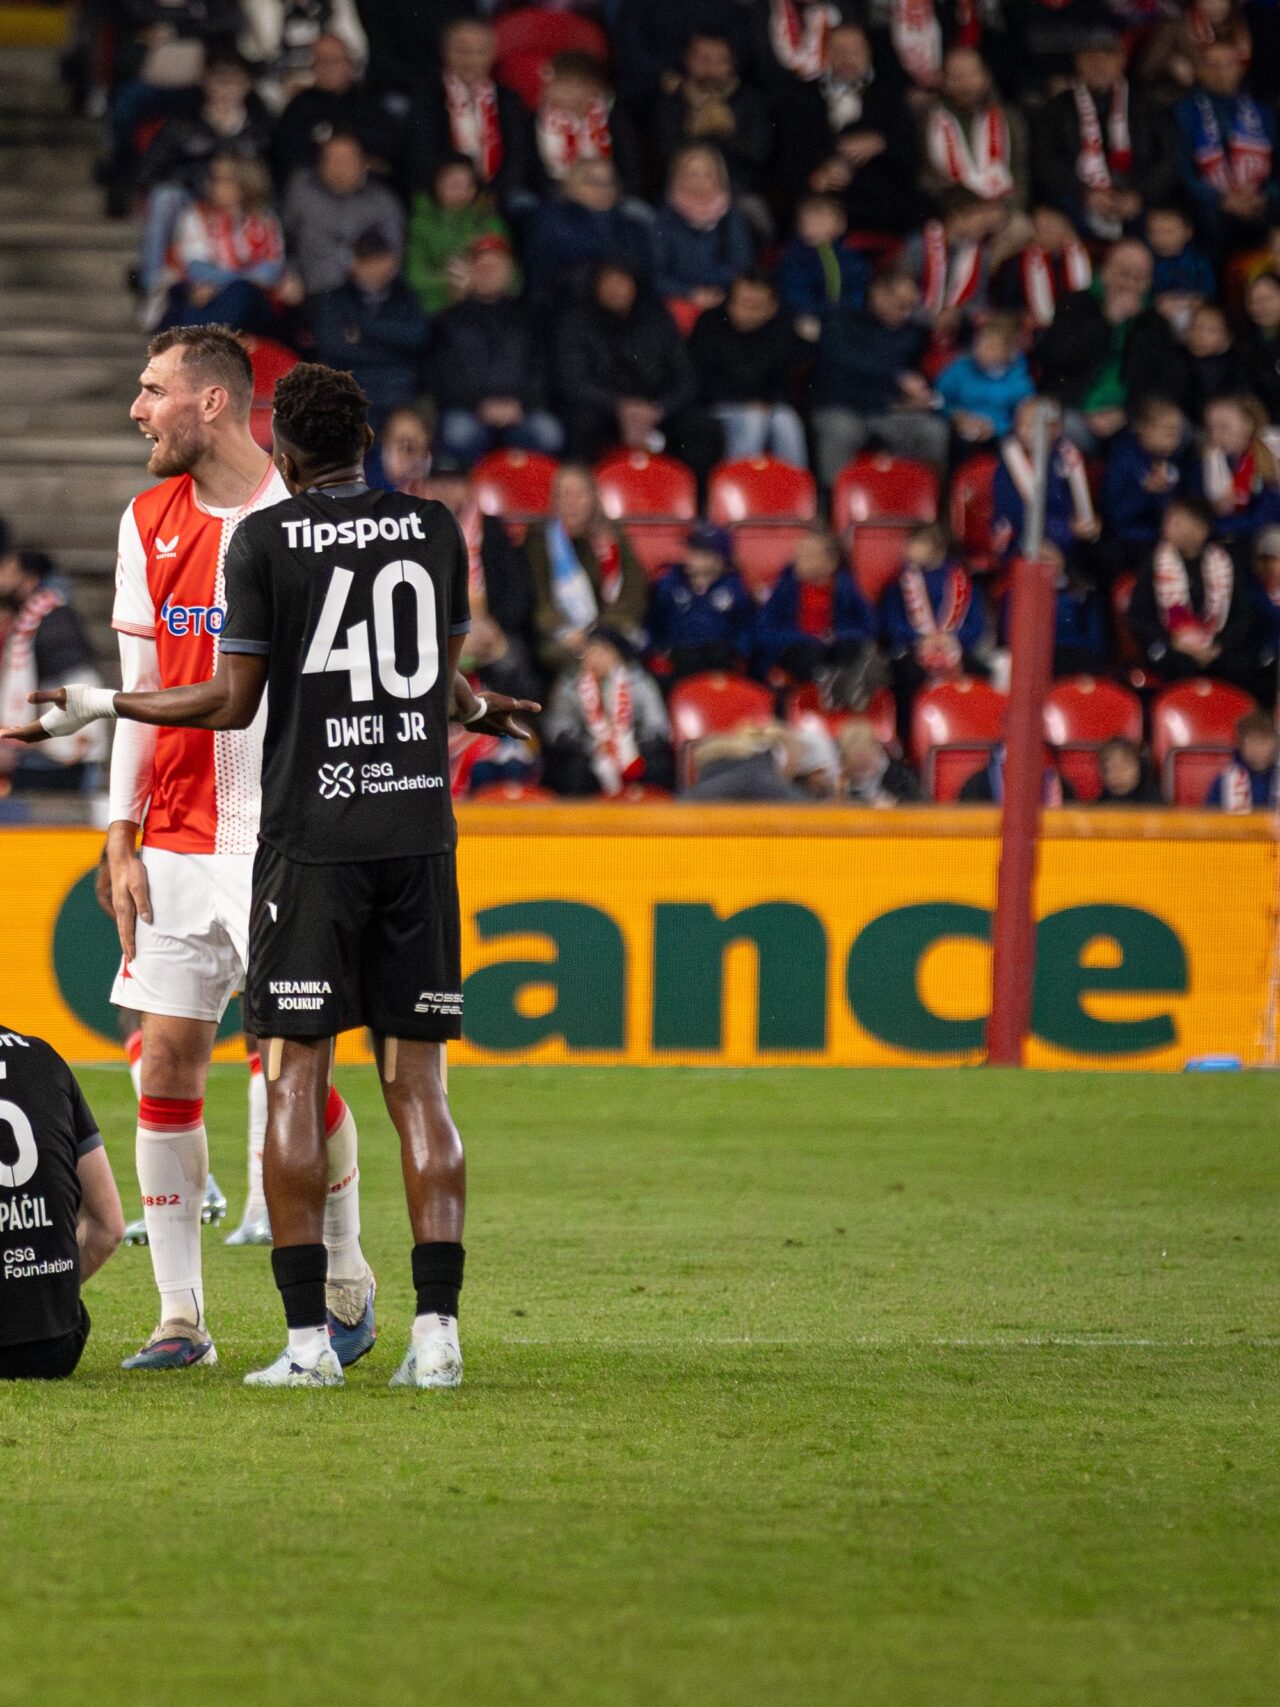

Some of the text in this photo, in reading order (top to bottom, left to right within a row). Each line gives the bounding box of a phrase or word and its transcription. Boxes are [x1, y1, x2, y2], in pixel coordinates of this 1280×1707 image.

[281, 512, 426, 553] Tipsport
[302, 559, 439, 702] 40
[325, 712, 427, 748] DWEH JR
[361, 762, 394, 779] CSG
[361, 775, 444, 795] Foundation
[52, 898, 1192, 1058] Cance
[269, 981, 332, 995] KERAMIKA
[278, 997, 324, 1011] SOUKUP
[3, 1247, 36, 1263] CSG
[4, 1258, 74, 1280] Foundation
